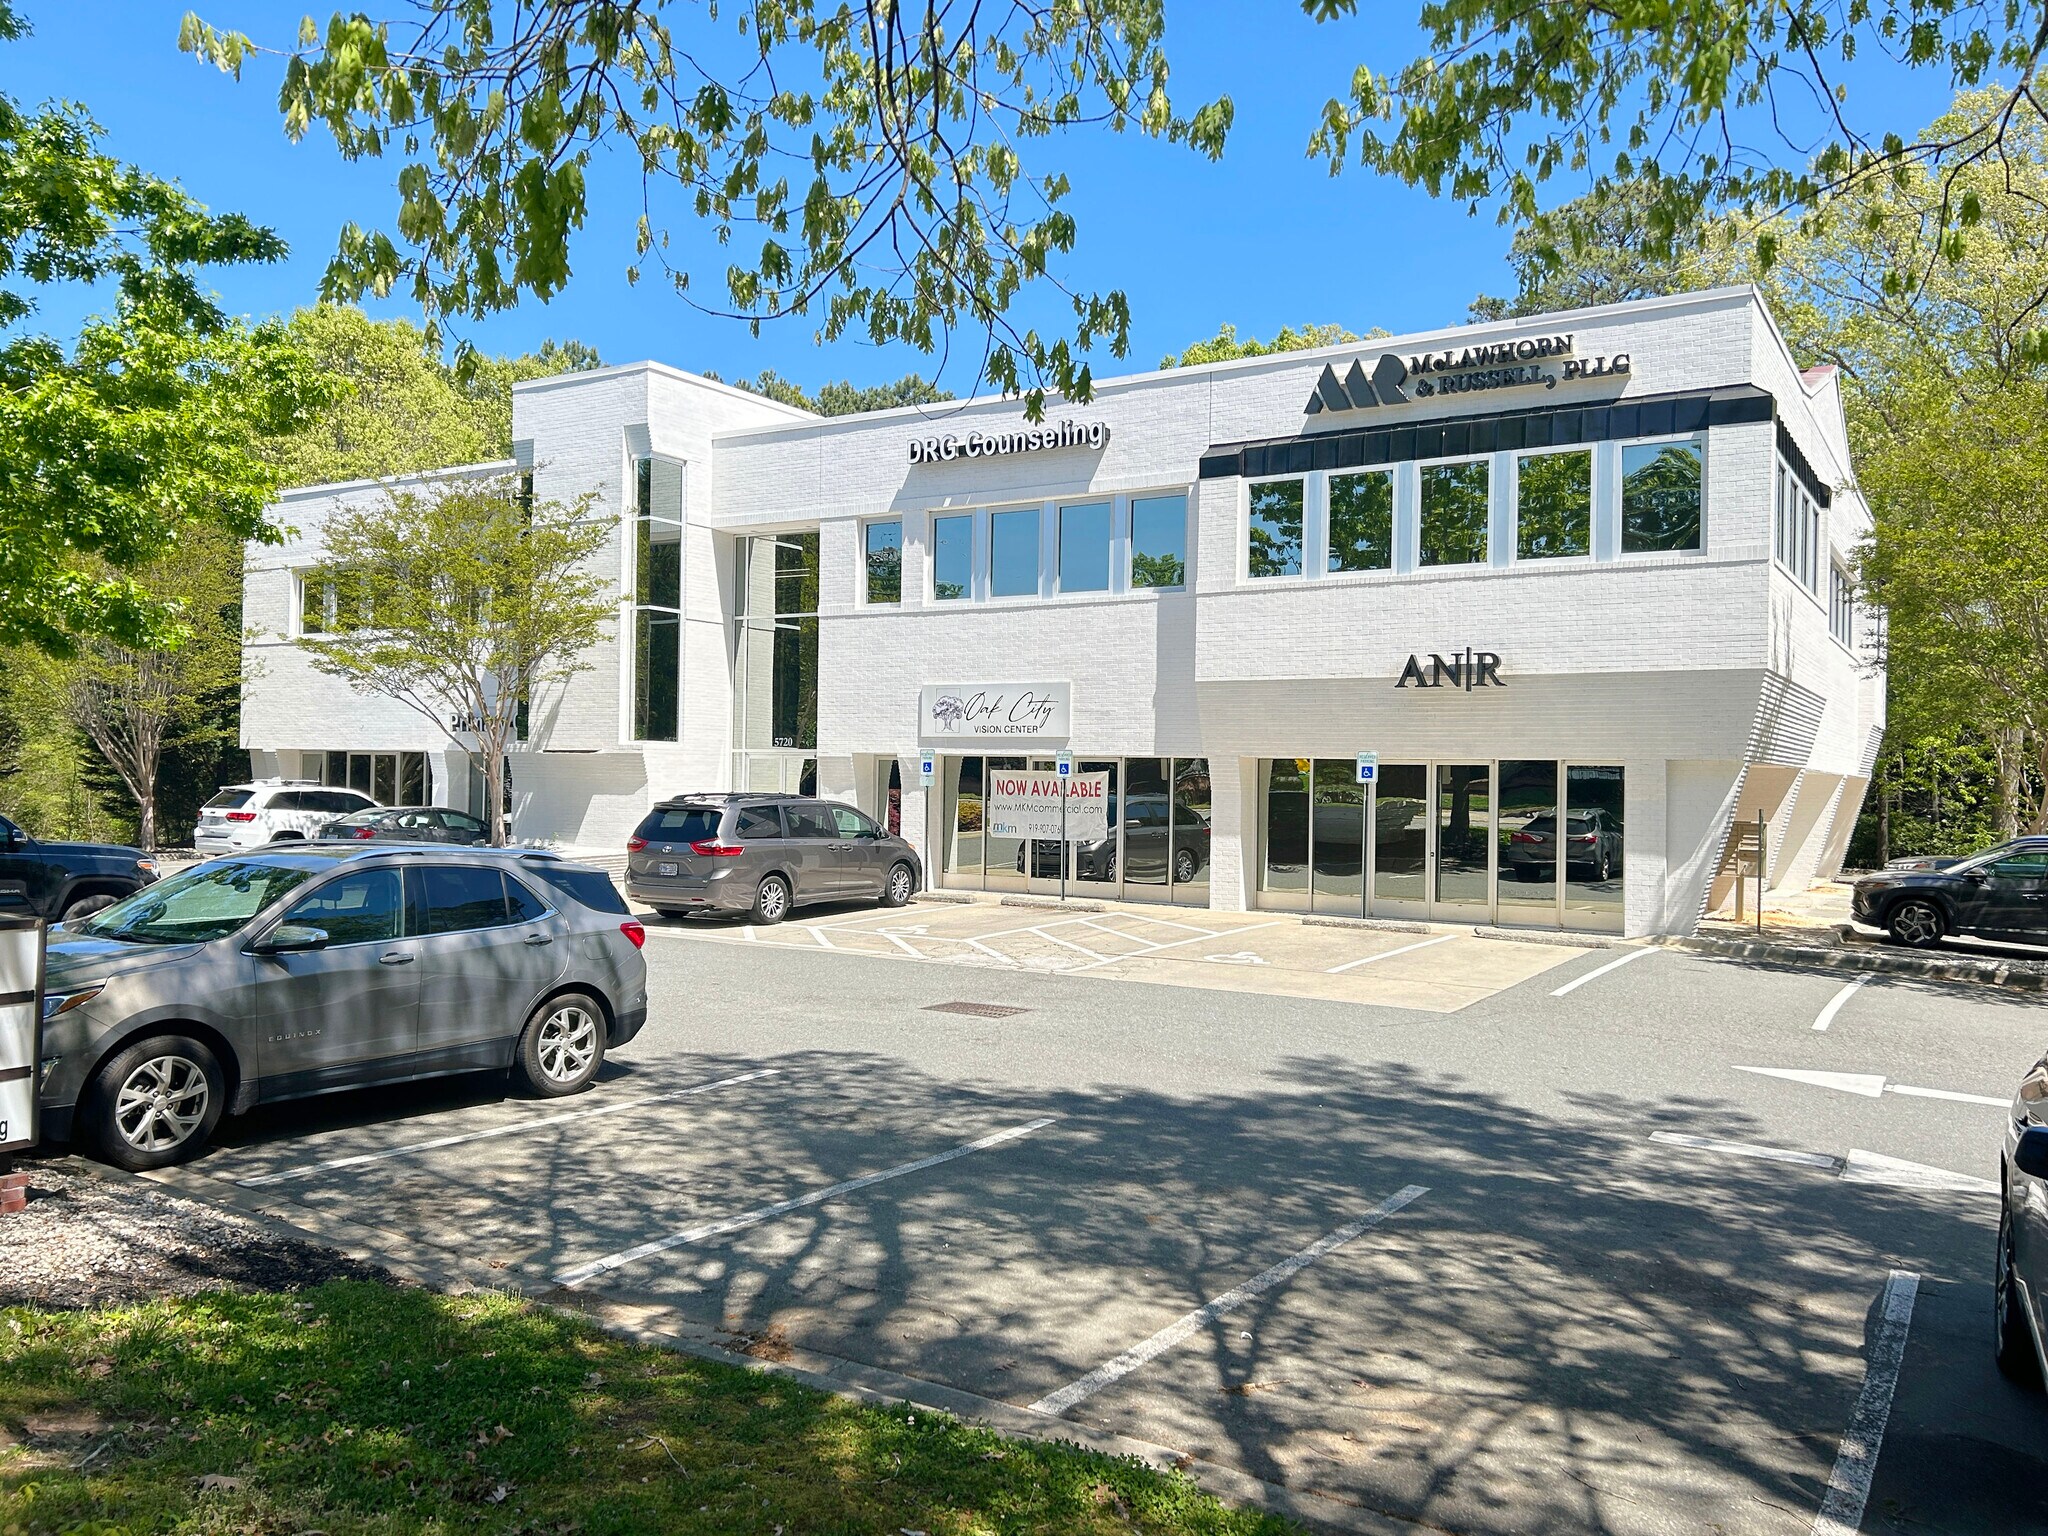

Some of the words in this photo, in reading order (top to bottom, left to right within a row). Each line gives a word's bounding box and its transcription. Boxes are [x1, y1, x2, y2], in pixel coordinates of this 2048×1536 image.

[1415, 378, 1434, 398] &
[1437, 364, 1557, 395] RUSSELL,
[1562, 353, 1631, 381] PLLC
[907, 433, 959, 464] DRG
[965, 419, 1110, 458] Counseling
[963, 691, 1004, 721] Oak
[1008, 691, 1059, 729] City
[974, 726, 1002, 734] VISION
[1004, 725, 1039, 734] CENTER
[774, 737, 793, 747] 5720
[996, 779, 1027, 796] NOW
[1030, 780, 1102, 798] AVAIABLE
[992, 822, 1017, 834] mkm
[268, 1029, 321, 1042] EQUINOX
